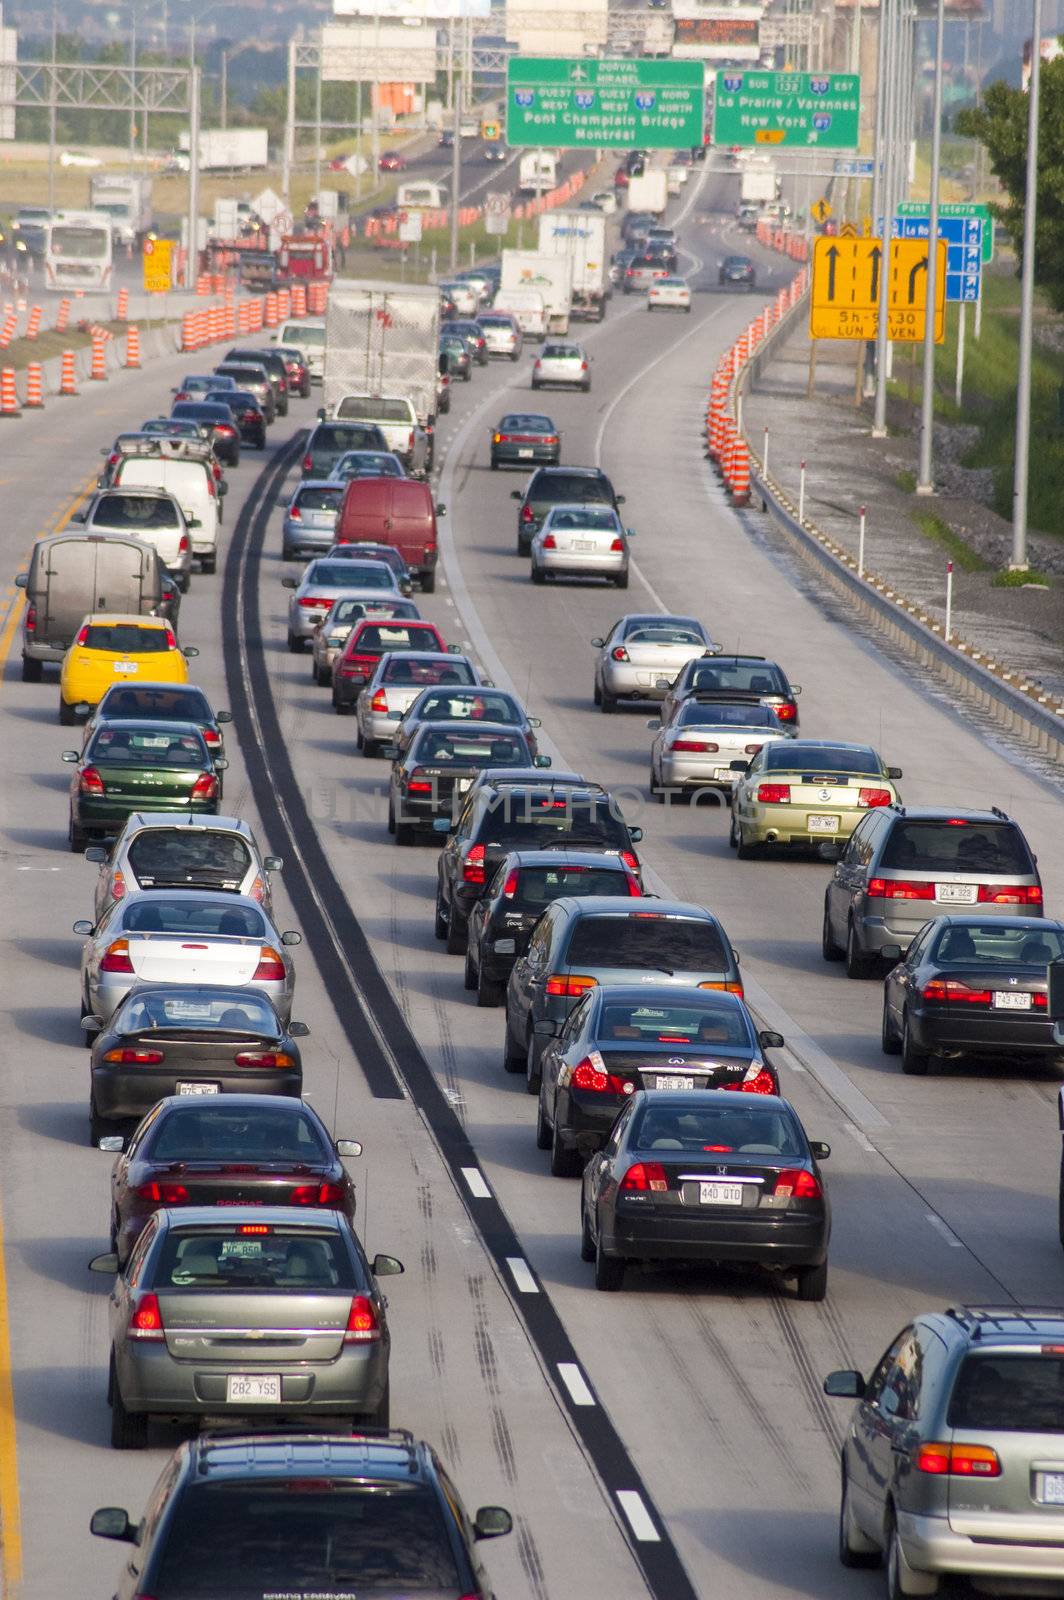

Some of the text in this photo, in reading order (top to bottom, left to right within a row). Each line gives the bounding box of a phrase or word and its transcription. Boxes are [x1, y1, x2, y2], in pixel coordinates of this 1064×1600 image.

[779, 82, 798, 92] 132
[812, 82, 827, 91] 20
[834, 82, 854, 92] EST
[661, 90, 690, 100] NORD
[601, 102, 629, 112] WEST
[658, 104, 693, 114] NORTH
[718, 96, 734, 108] La
[739, 96, 783, 109] Prairie
[796, 97, 857, 111] Varennes
[524, 112, 686, 129] Pont Champlain Bridge
[741, 115, 769, 127] New
[776, 115, 807, 128] York
[575, 128, 636, 141] Montréal
[902, 204, 976, 214] Pont ictoria
[906, 225, 916, 236] La
[838, 325, 864, 337] LUN
[890, 326, 916, 338] VEN
[232, 1382, 277, 1396] 282 YSS
